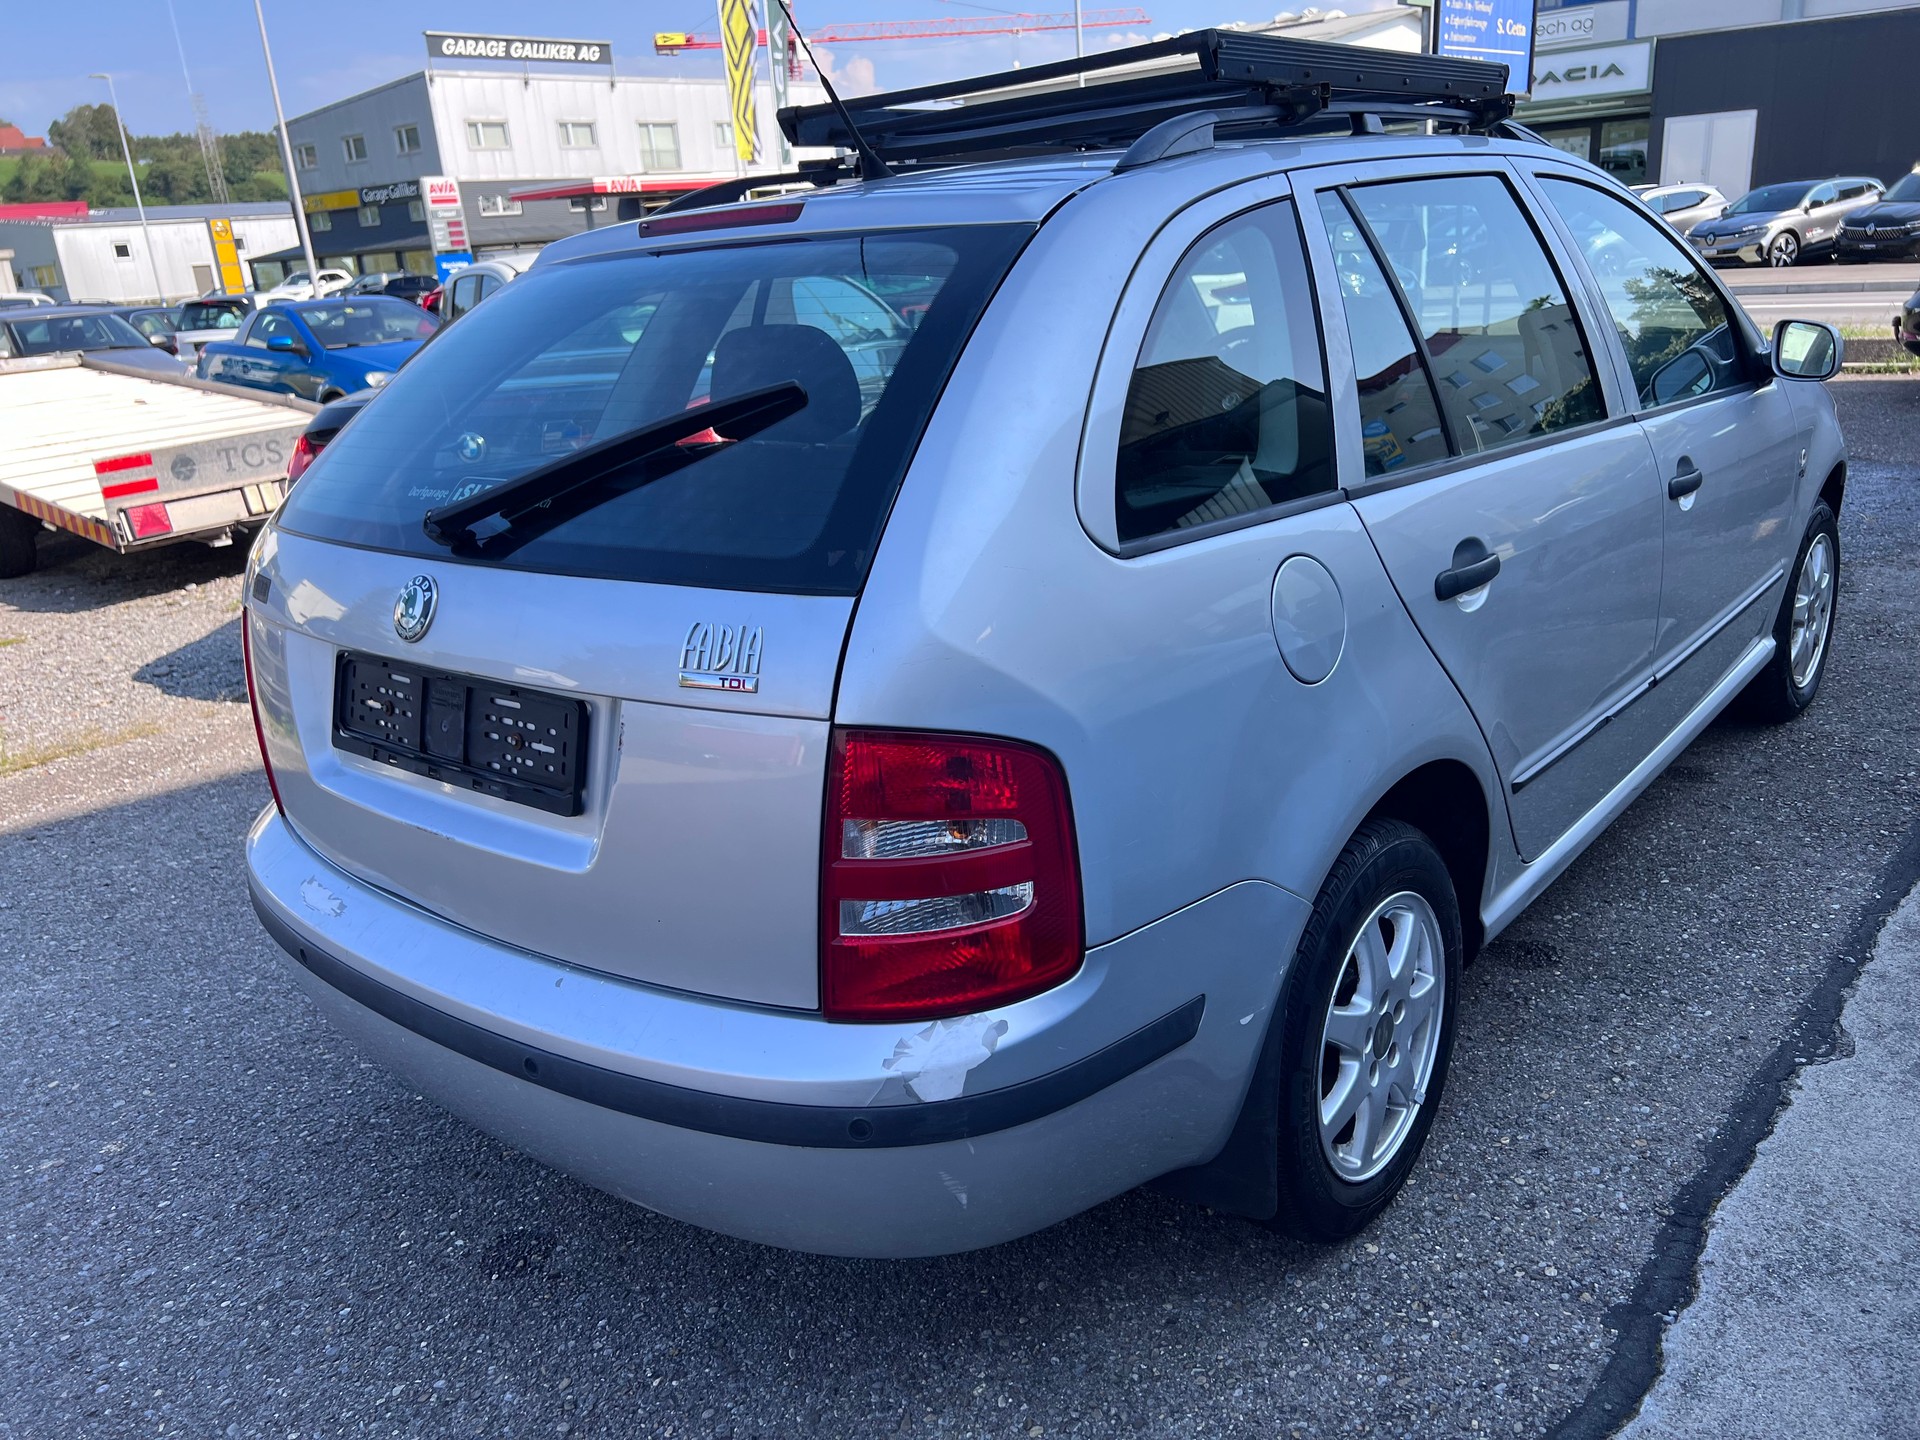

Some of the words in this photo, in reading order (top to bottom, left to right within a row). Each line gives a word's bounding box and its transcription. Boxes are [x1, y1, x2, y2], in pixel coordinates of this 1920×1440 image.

[1571, 18, 1594, 33] ag
[442, 38, 506, 57] GARAGE
[510, 41, 576, 60] GALLIKER
[578, 45, 601, 61] AG
[362, 188, 389, 205] Garage
[217, 440, 284, 472] TCS
[679, 622, 763, 674] FABIA
[719, 677, 746, 690] TDI
